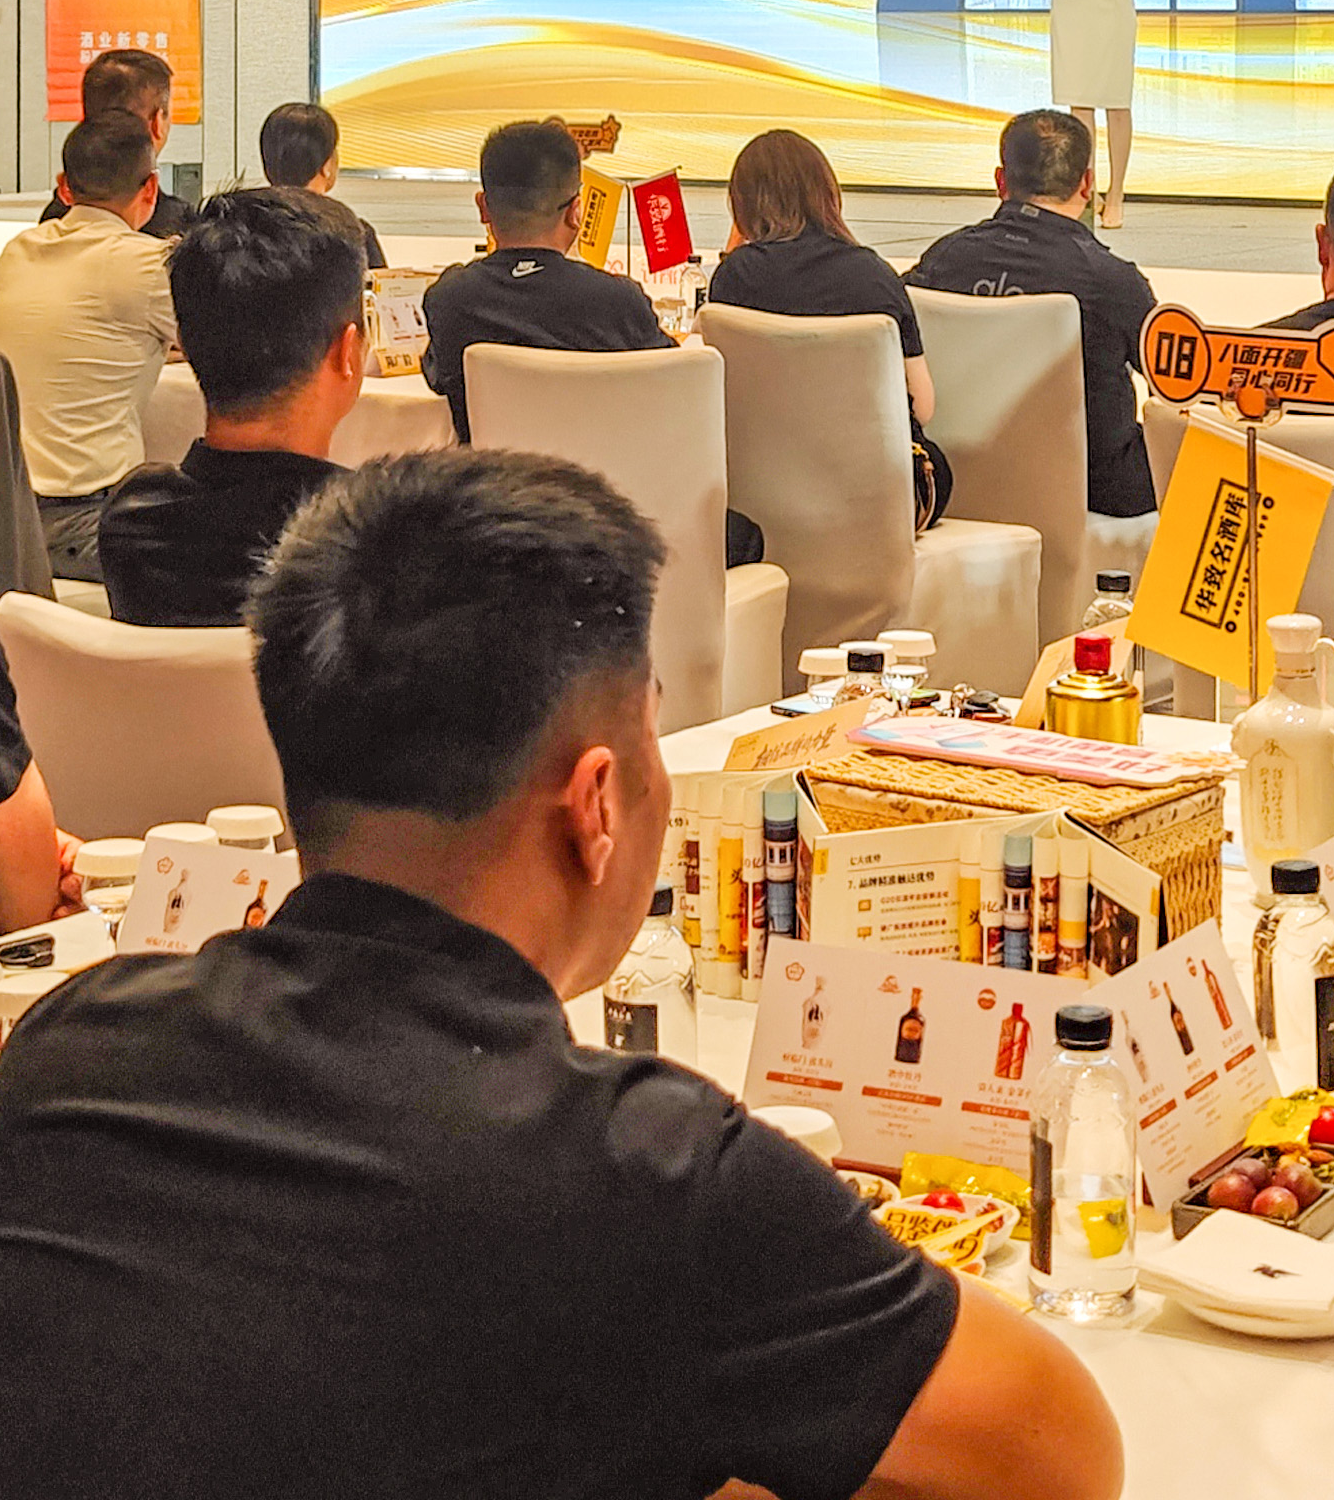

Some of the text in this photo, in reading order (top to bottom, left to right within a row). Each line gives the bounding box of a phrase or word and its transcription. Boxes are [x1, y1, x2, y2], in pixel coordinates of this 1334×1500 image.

[80, 31, 169, 49] 酒业新零售
[1154, 331, 1198, 381] 08
[1228, 367, 1319, 394] 同心同行
[1194, 491, 1249, 614] 华致名酒库
